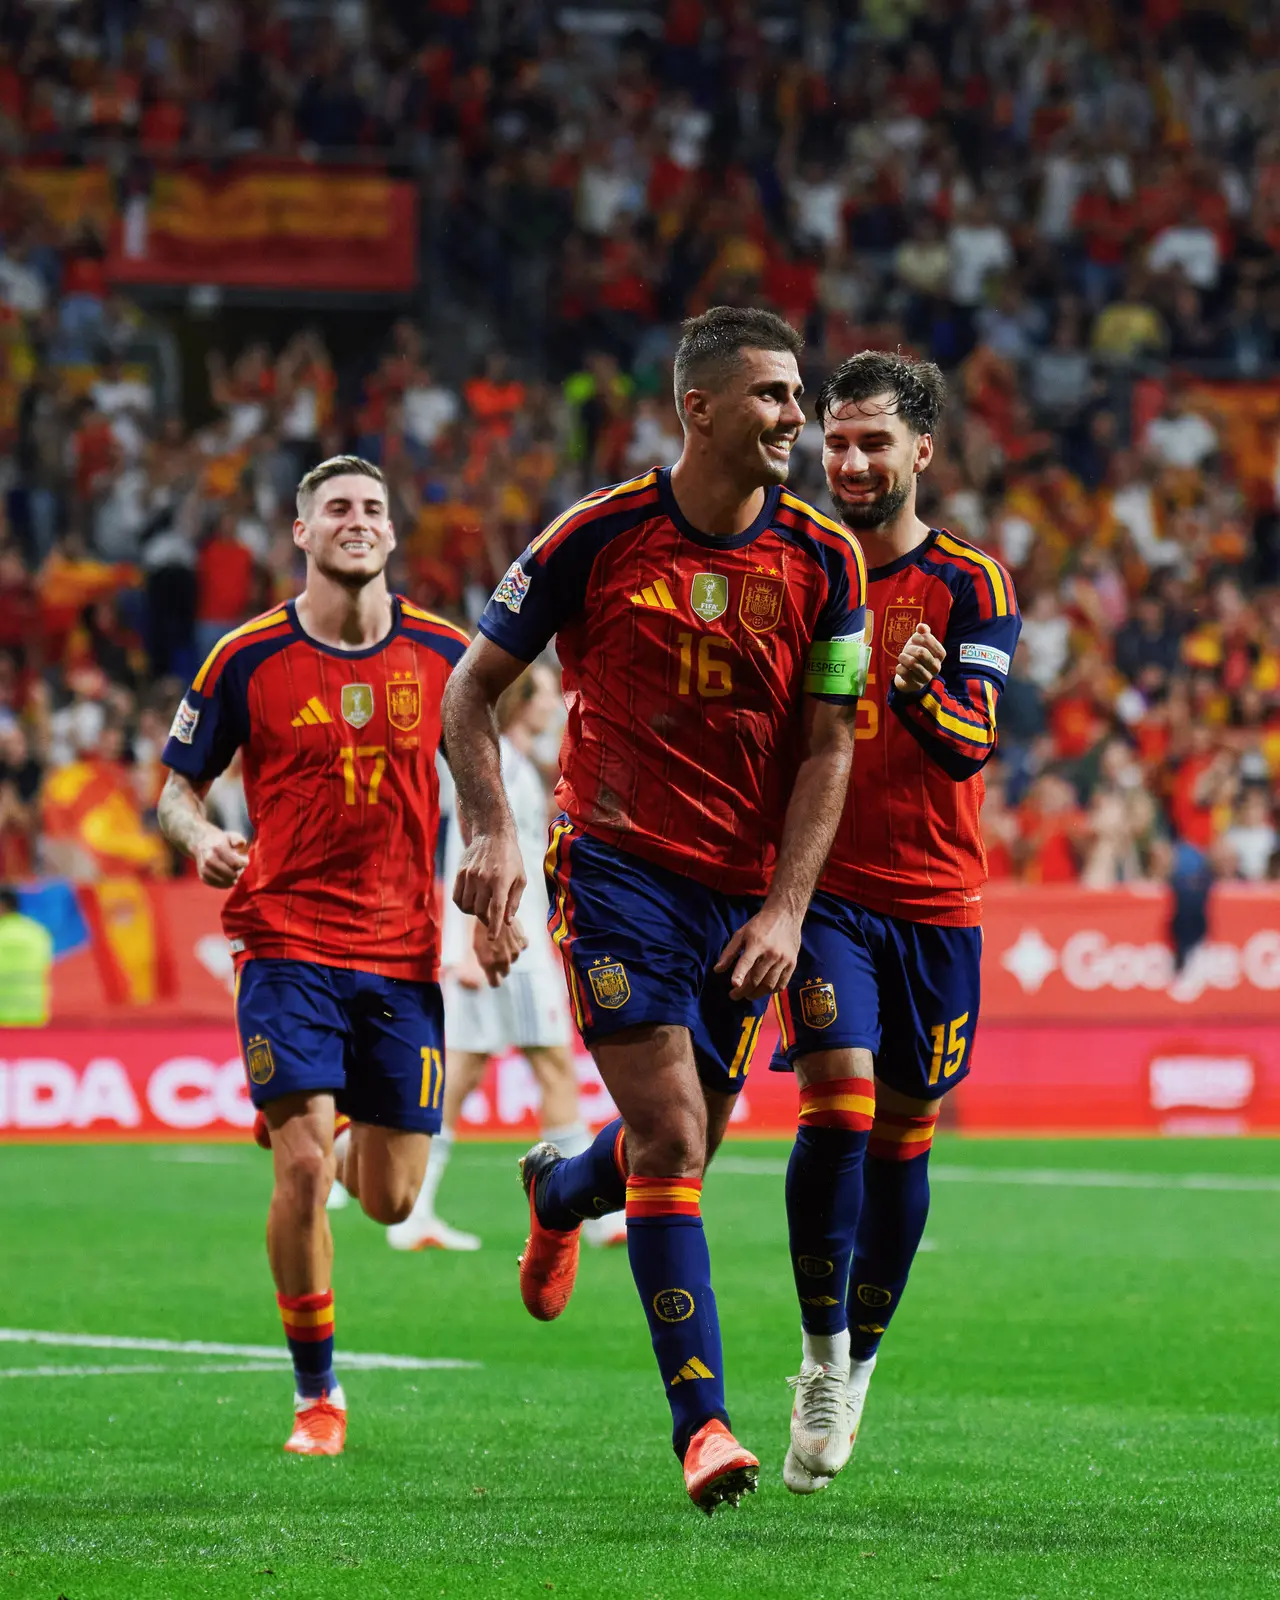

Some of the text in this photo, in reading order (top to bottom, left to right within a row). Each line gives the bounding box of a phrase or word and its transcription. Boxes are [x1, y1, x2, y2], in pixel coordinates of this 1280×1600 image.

[700, 602, 717, 610] FIFA
[677, 633, 733, 698] 16
[340, 745, 386, 805] 17
[927, 1011, 969, 1086] 15
[0, 1057, 142, 1128] DA
